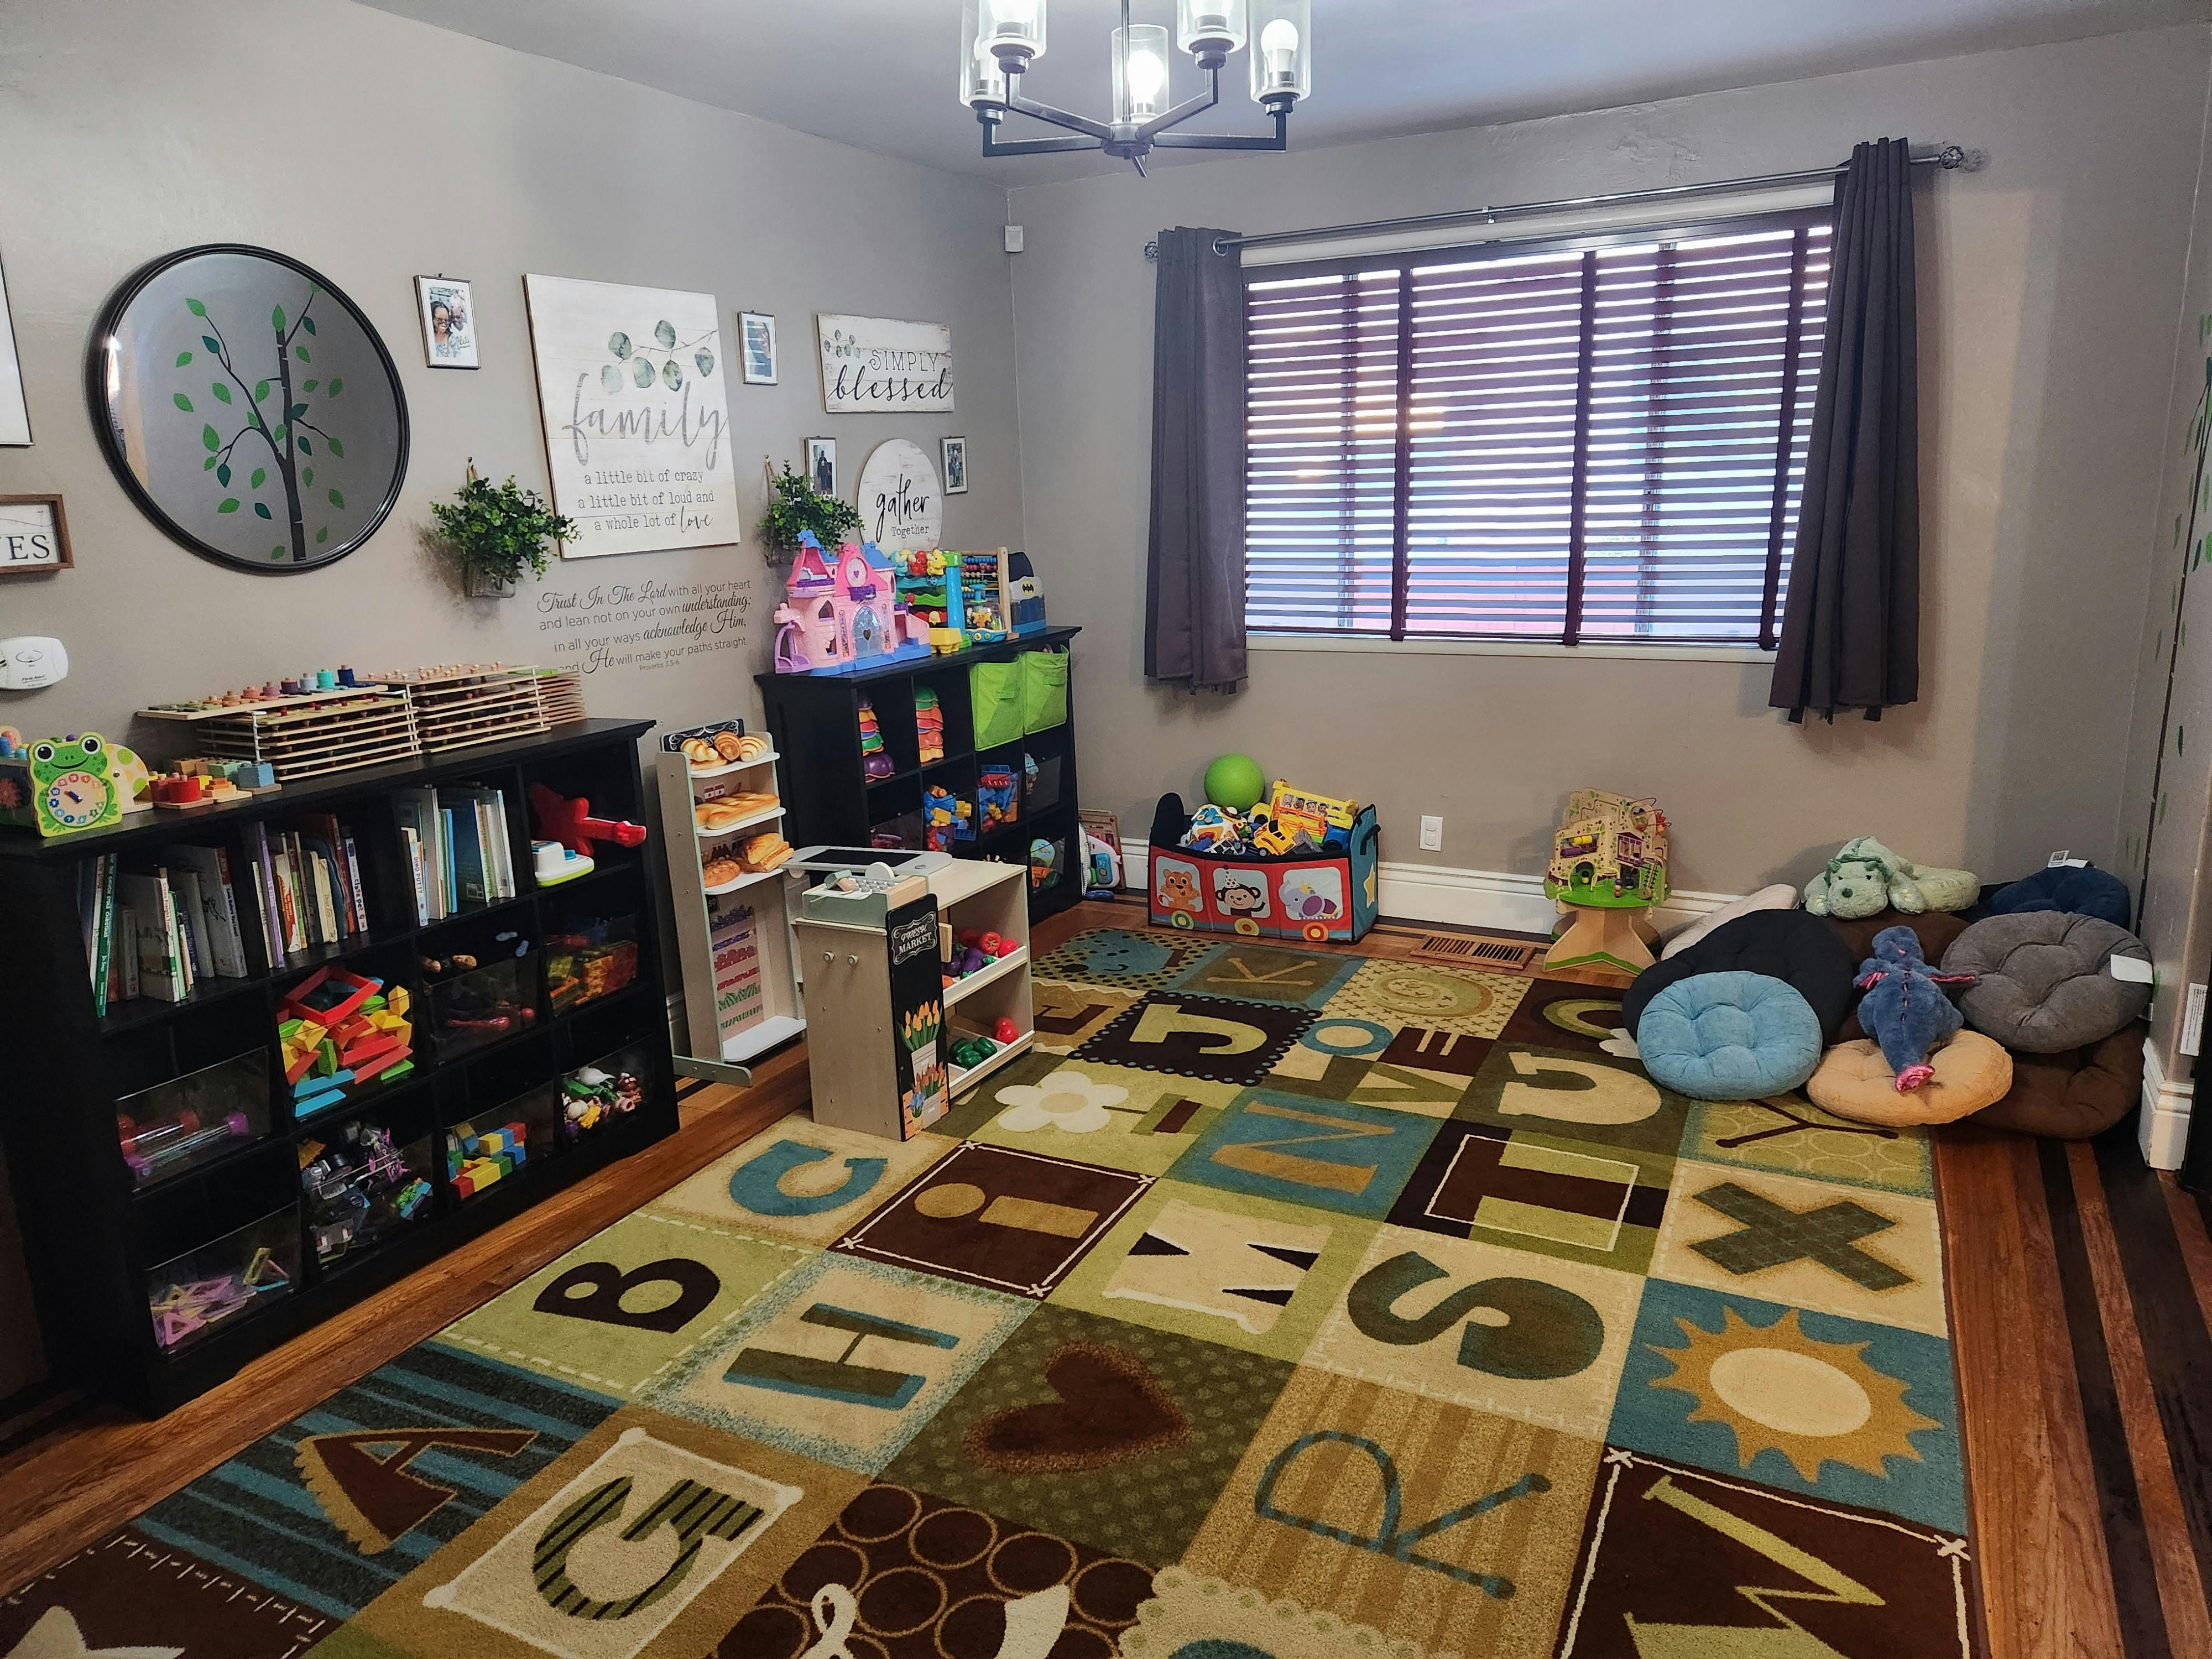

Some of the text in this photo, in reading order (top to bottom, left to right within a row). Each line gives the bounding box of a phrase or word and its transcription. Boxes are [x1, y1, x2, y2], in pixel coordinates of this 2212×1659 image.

[827, 364, 953, 401] blessed
[869, 349, 938, 372] SIMPLY
[562, 373, 729, 471] family
[578, 491, 714, 509] a little bit of loud and
[585, 469, 703, 484] a little bit of crazy
[594, 505, 713, 533] a whole lot of love
[875, 473, 929, 543] gather
[891, 524, 929, 539] Together
[0, 534, 50, 560] ES
[537, 580, 751, 613] Trust In The Lord with all your heart
[540, 617, 562, 630] and
[566, 614, 590, 628] lean
[593, 613, 612, 624] not
[615, 611, 629, 620] on
[633, 608, 655, 622] your
[659, 607, 681, 616] own
[555, 609, 747, 653] in all your ways acknowledge Him,
[582, 648, 614, 674] He
[616, 653, 633, 665] will
[636, 650, 661, 662] make
[664, 647, 685, 660] your
[687, 643, 713, 656] paths
[715, 637, 747, 650] straight
[639, 662, 664, 671] Proverbs
[899, 932, 932, 954] MARKET
[901, 924, 927, 942] FRESH
[1207, 957, 1316, 986] K
[1129, 1004, 1267, 1055] J
[1497, 1050, 1662, 1125] U
[1210, 1100, 1395, 1196] N
[728, 1139, 888, 1217] C
[1386, 1119, 1669, 1238] T
[1690, 1182, 1917, 1292] X
[1103, 1199, 1335, 1336] M
[533, 1258, 720, 1334] B
[1348, 1251, 1605, 1381] S
[719, 1303, 961, 1410] H
[295, 1427, 538, 1555] A
[1255, 1429, 1552, 1600] R
[532, 1476, 764, 1621] G
